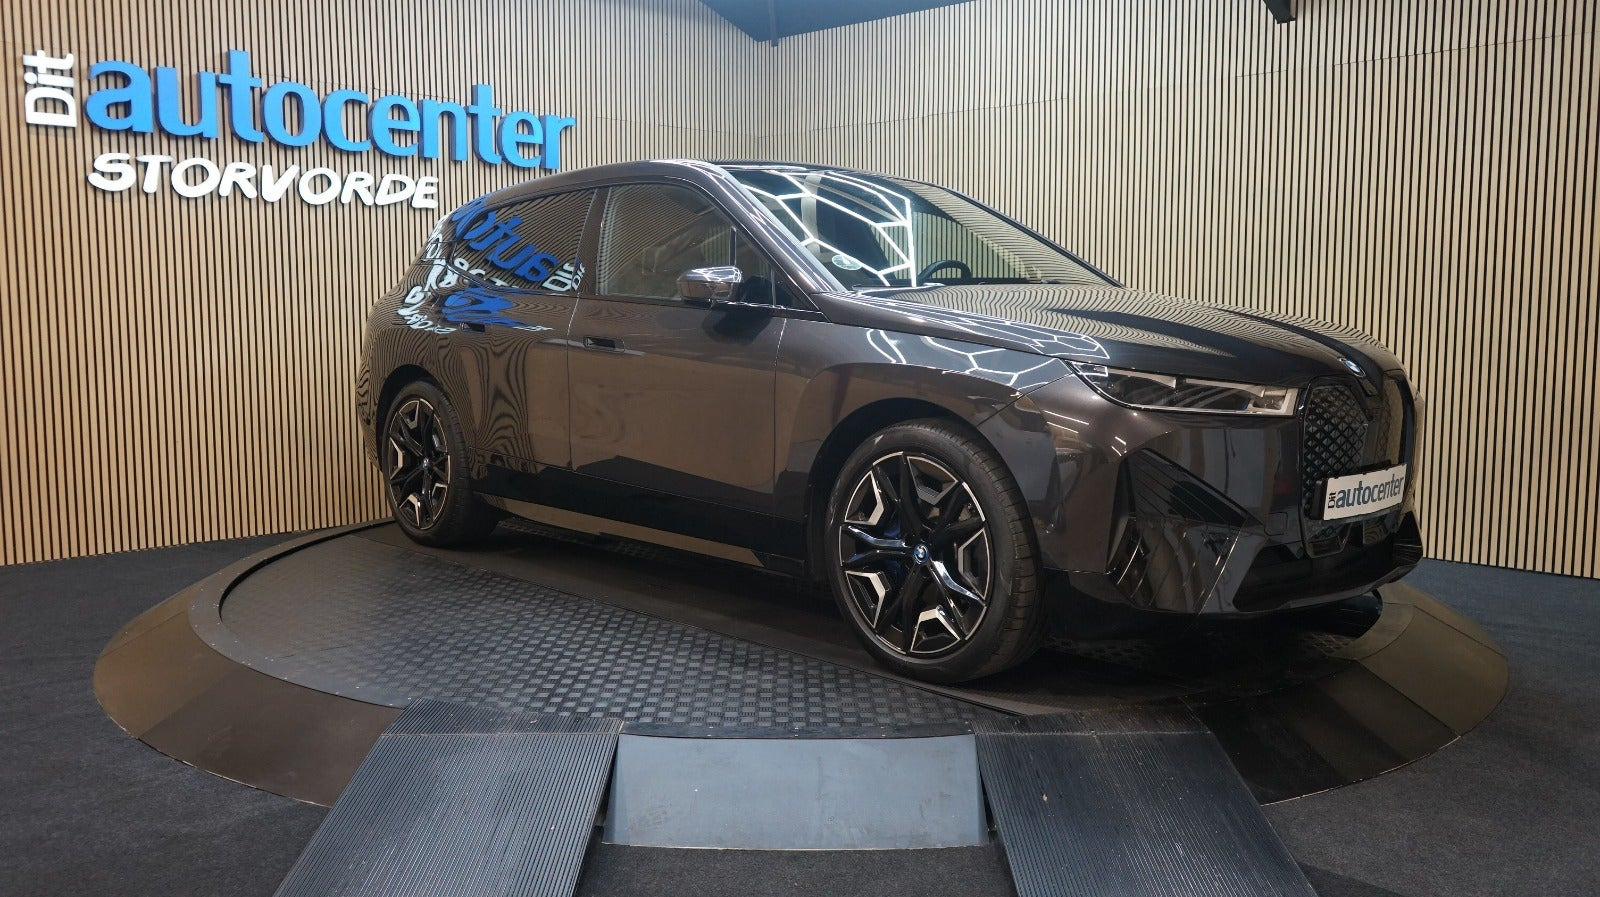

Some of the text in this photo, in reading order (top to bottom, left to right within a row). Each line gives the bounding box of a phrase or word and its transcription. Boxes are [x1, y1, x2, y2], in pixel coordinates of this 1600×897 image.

[24, 49, 576, 170] Dit autocenter
[88, 152, 439, 208] STORVORDE
[1328, 474, 1404, 509] Dit autocenter
